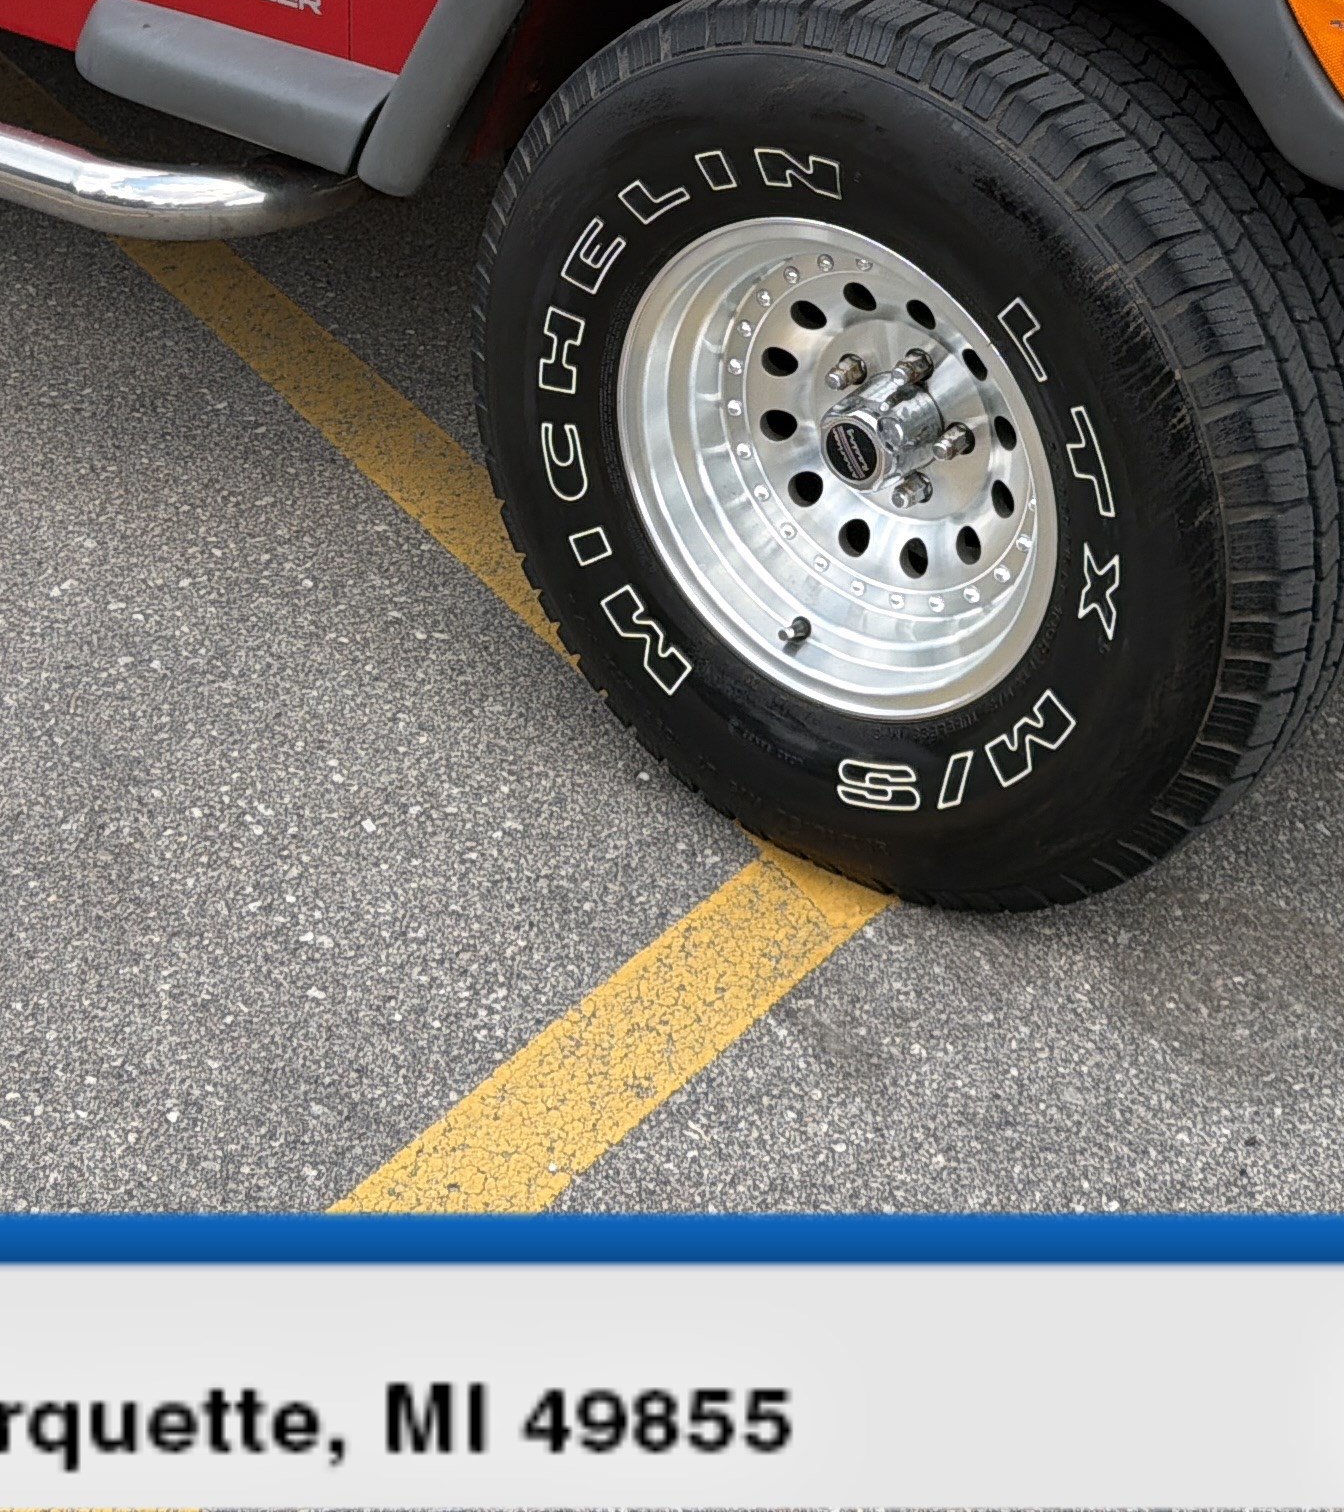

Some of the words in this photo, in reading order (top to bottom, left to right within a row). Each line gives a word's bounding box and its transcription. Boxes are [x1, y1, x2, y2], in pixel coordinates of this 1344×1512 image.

[538, 147, 843, 696] MICHELIN
[997, 297, 1121, 641] LTX
[836, 689, 1077, 813] M/S
